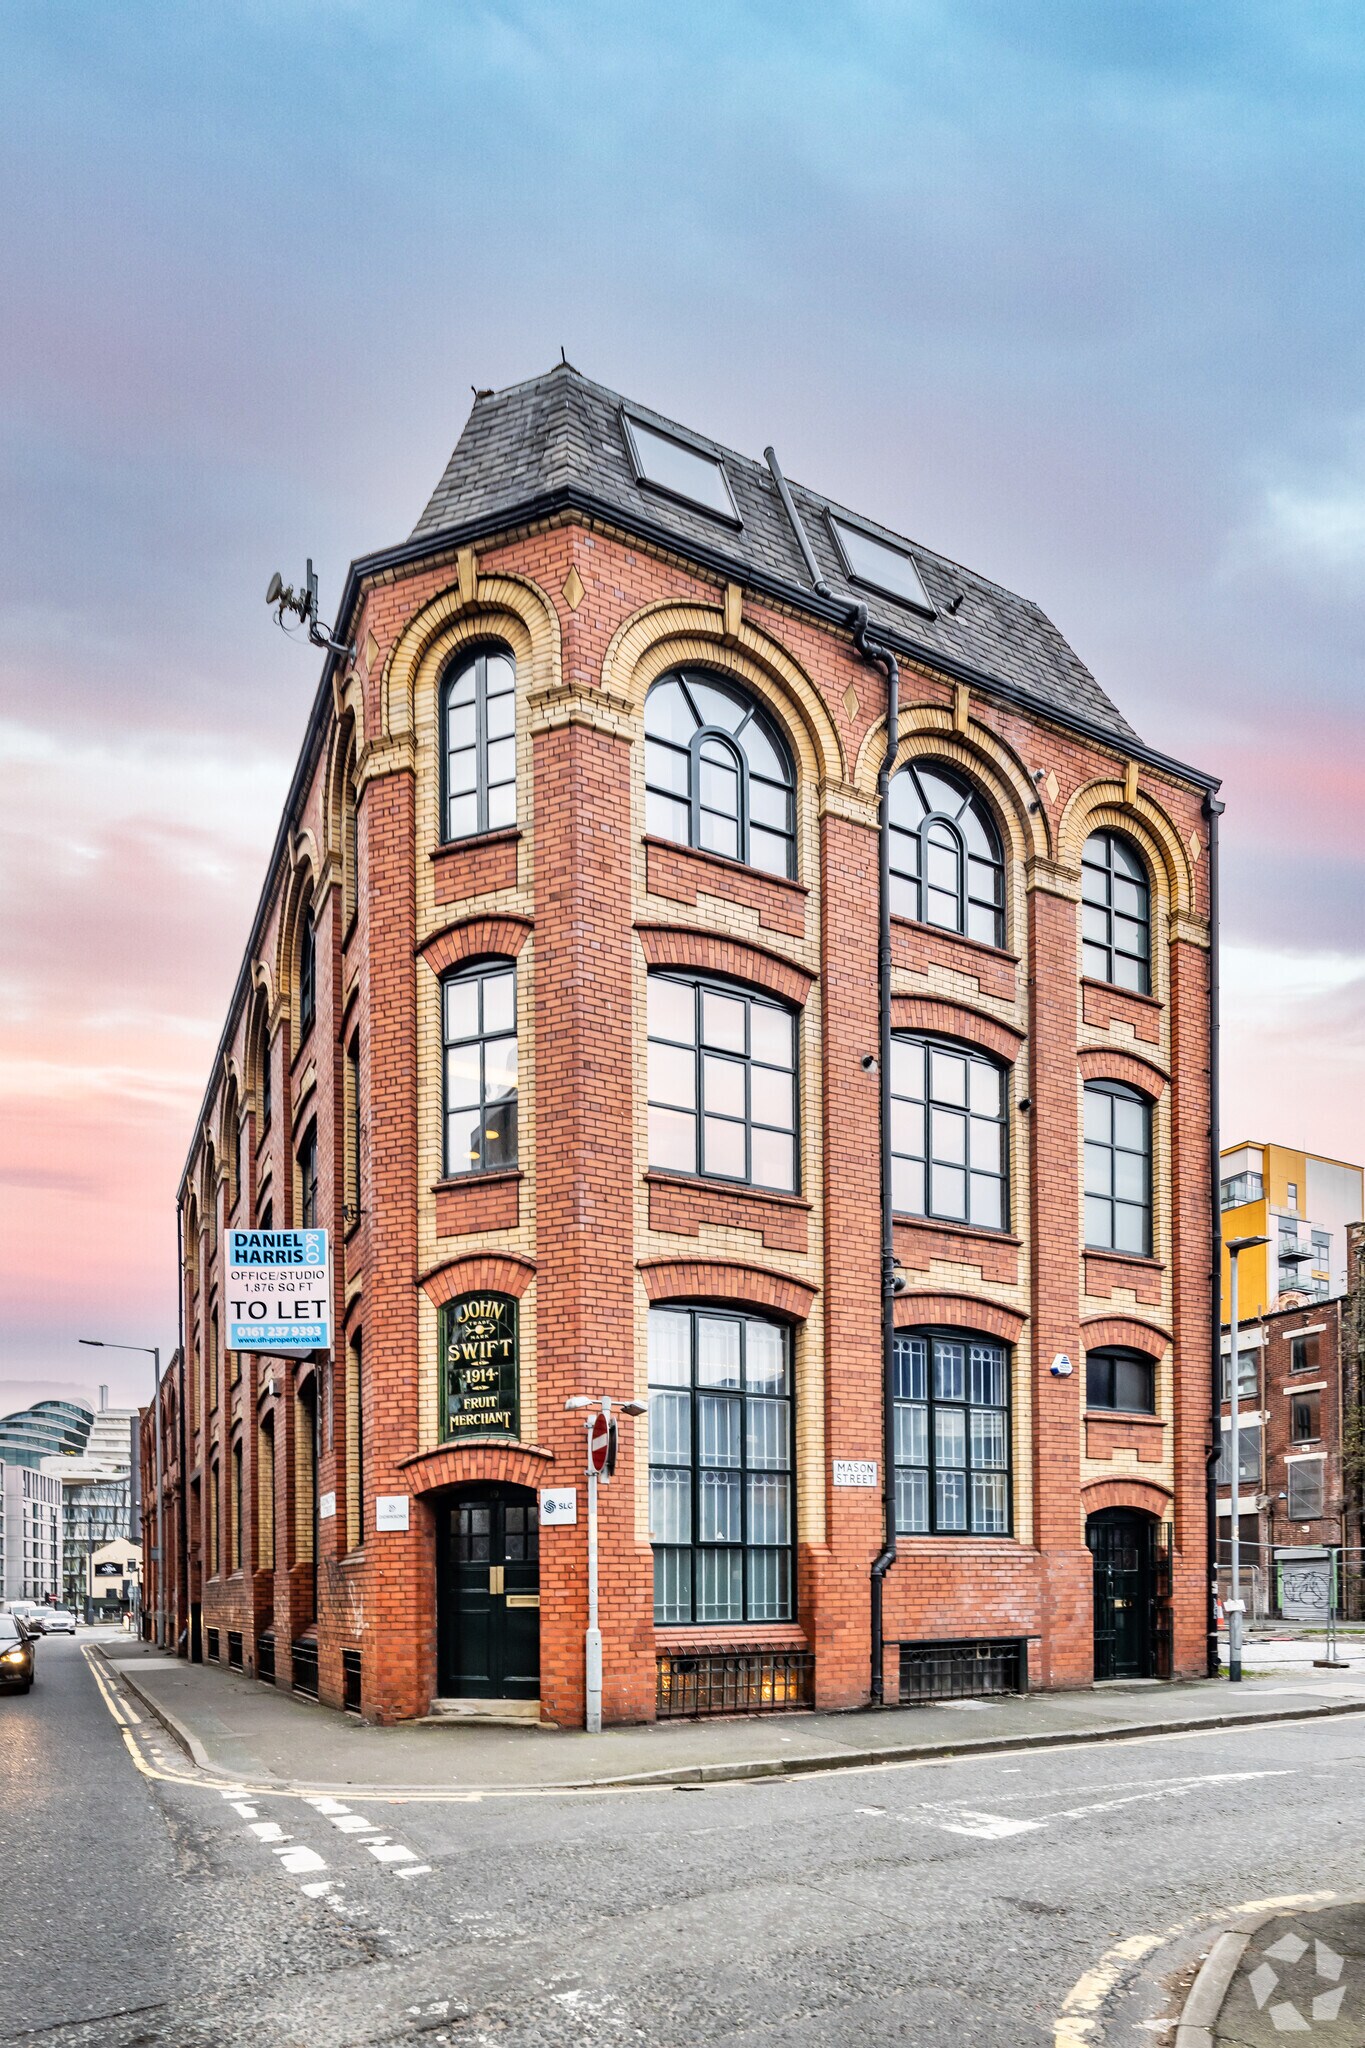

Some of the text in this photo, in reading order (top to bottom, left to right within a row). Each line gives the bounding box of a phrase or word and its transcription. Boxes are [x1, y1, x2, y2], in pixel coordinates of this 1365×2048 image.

[235, 1233, 302, 1247] DANIEL
[305, 1233, 319, 1264] &CO
[235, 1249, 303, 1263] HARRIS
[231, 1270, 325, 1280] OFFICE/STUDIO
[244, 1282, 313, 1292] 1,876 SQ FT
[231, 1300, 326, 1319] TO LET
[458, 1301, 505, 1322] JOHN
[237, 1326, 322, 1336] 0161 237 9393
[237, 1336, 321, 1344] www.dh-property.co.uk
[448, 1339, 512, 1361] SWIFT
[463, 1396, 497, 1410] FRUIT
[450, 1411, 511, 1433] MERCHANT
[837, 1462, 874, 1473] MASON
[837, 1474, 874, 1484] STREET
[558, 1502, 573, 1510] SLG
